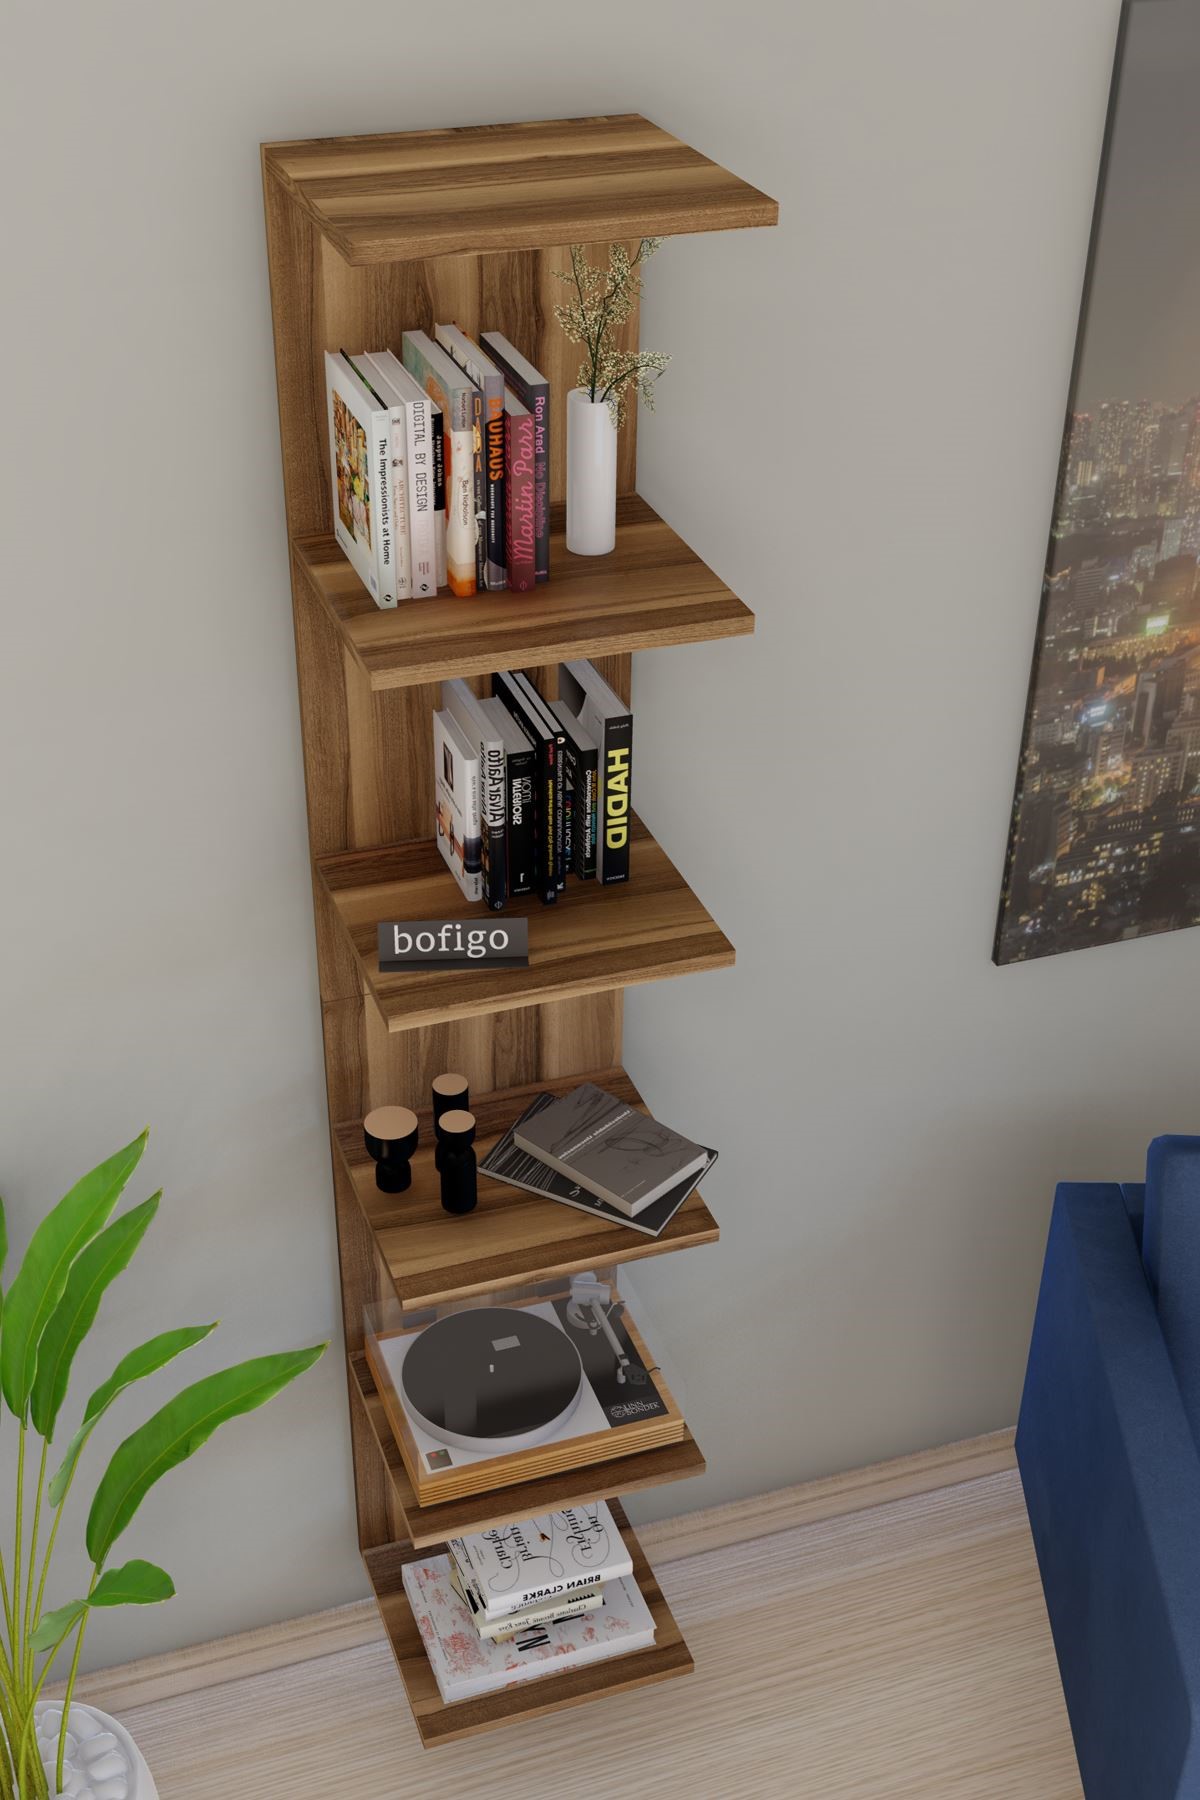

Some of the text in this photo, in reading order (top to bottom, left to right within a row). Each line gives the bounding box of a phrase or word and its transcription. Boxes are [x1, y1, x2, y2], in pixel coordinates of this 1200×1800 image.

[413, 401, 427, 446] DIGITAL
[488, 397, 504, 481] BAUHAUS
[535, 396, 545, 453] Ron Arad
[414, 453, 427, 465] BY
[378, 439, 391, 566] The Impressionists at Home
[398, 479, 406, 536] ARCHITECTURE
[416, 473, 428, 512] DESIGN
[512, 418, 534, 561] Martin Parr
[535, 482, 546, 538] Discipline
[393, 924, 509, 958] bofigo
